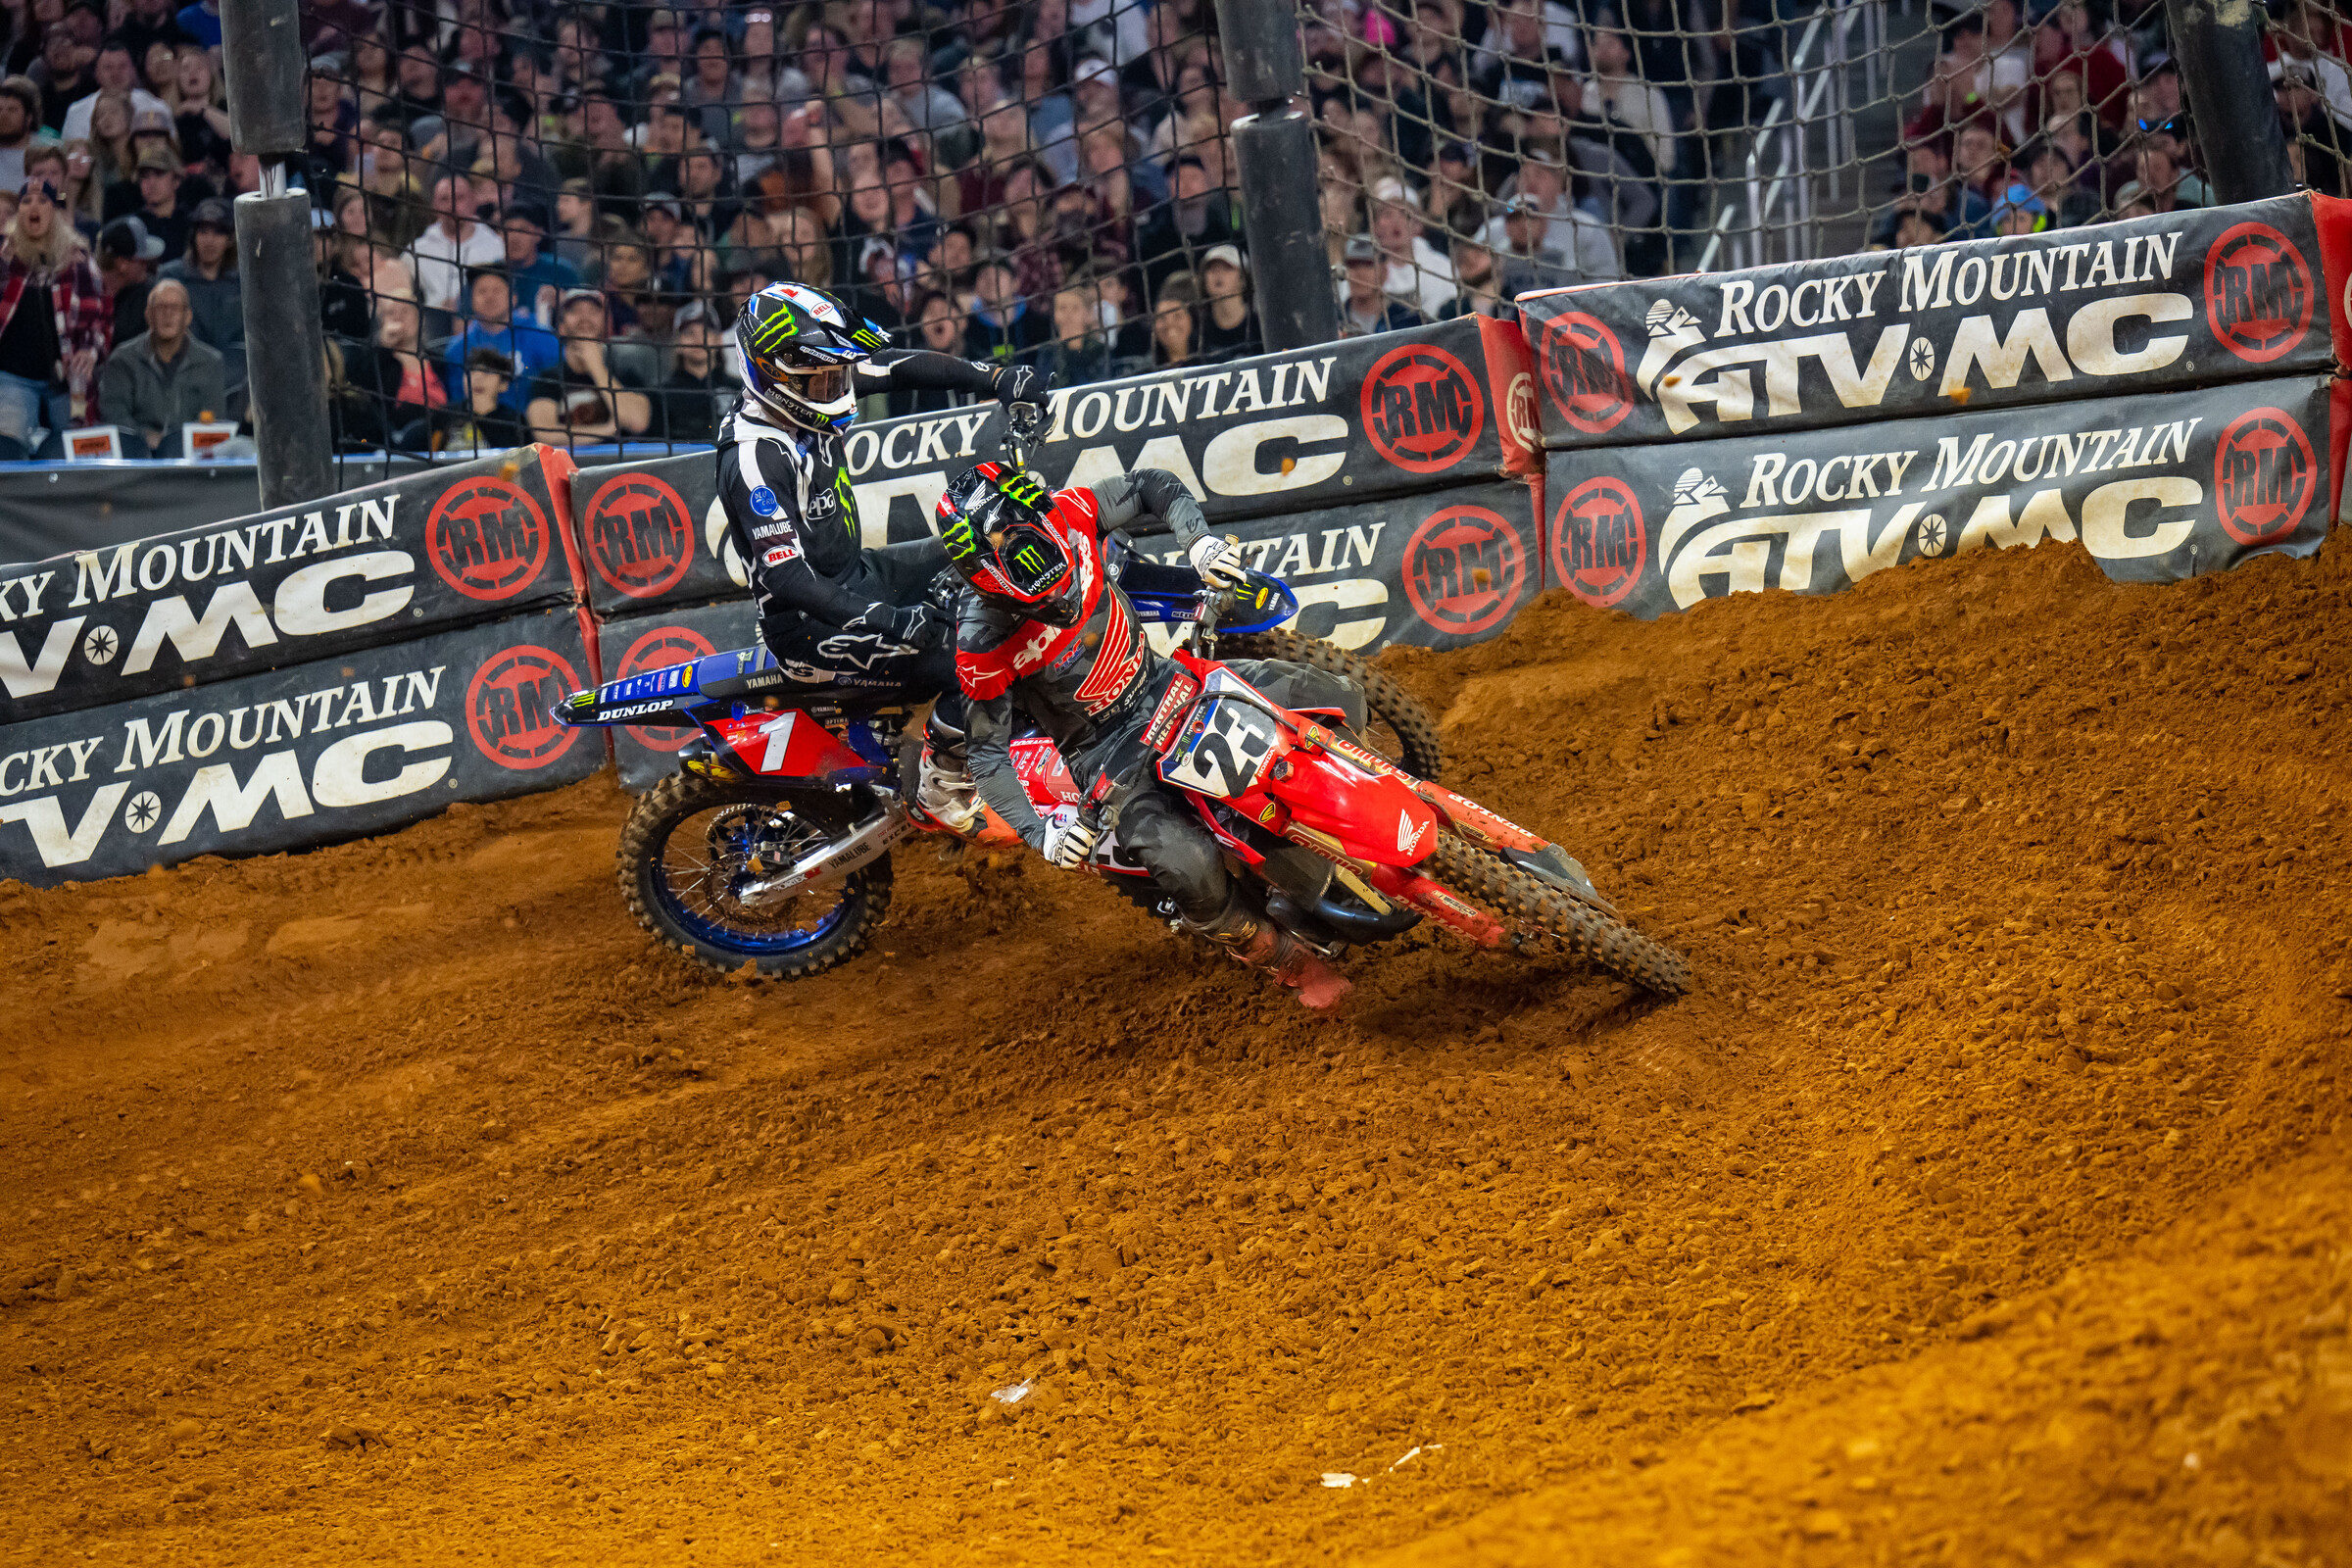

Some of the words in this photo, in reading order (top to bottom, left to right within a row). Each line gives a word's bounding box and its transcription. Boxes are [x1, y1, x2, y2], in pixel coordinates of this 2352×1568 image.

[1714, 270, 1886, 338] ROCKY
[1898, 231, 2182, 313] MOUNTAIN
[813, 303, 831, 316] BELL
[767, 388, 812, 417] MONSTER
[845, 411, 992, 476] OCKY
[1740, 451, 1918, 509] ROCKY
[1921, 417, 2203, 492] MOUNTAIN
[970, 492, 999, 515] HONDA
[752, 520, 793, 540] YAMALUBE
[69, 494, 400, 608] MOUNTAIN
[768, 549, 797, 563] BELL
[1028, 563, 1066, 594] MONSTER
[746, 674, 783, 689] YAMAHA
[597, 700, 673, 721] DUNLOP
[1145, 679, 1183, 743] RENTHAL
[0, 736, 104, 797] CKY
[114, 665, 446, 773] MOUNTAIN
[758, 711, 797, 772] 1
[1194, 696, 1276, 799] 23
[1257, 749, 1276, 777] HONDA
[1448, 794, 1537, 839] DUNLOP
[828, 841, 871, 870] YAMALUBE
[1407, 820, 1430, 857] HONDA
[1395, 894, 1478, 941] DUNLOP
